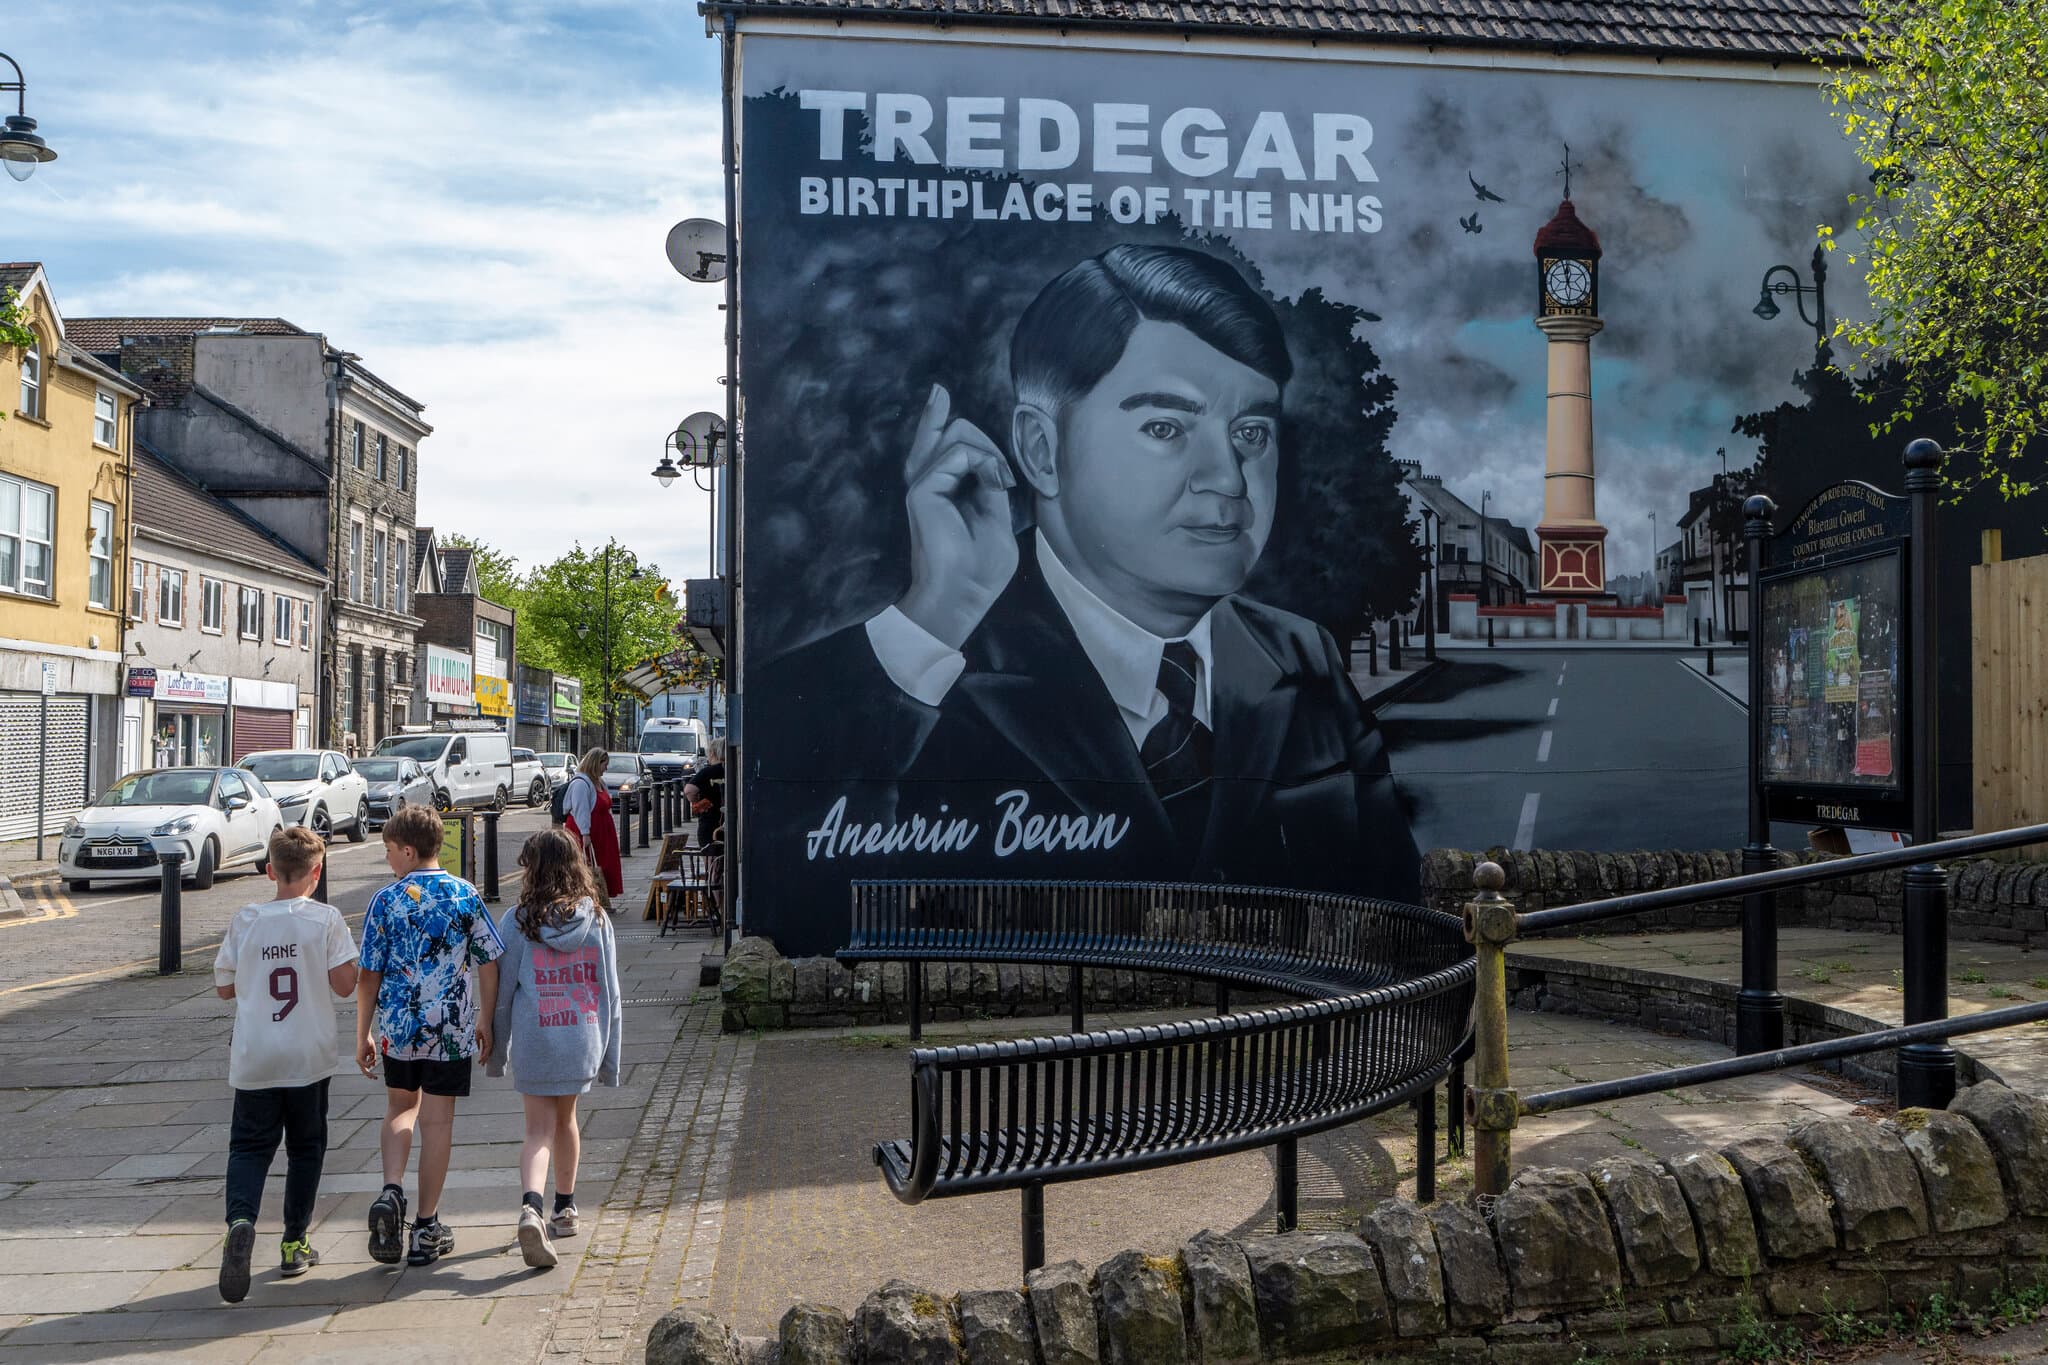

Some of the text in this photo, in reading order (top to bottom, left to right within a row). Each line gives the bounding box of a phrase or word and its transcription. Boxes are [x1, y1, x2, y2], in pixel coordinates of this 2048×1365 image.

[800, 89, 1379, 182] TREDEGAR
[800, 177, 1383, 233] BIRTHPLACE OF THE NHS
[1808, 507, 1866, 536] Blaenau Gwent
[1792, 524, 1884, 556] COUNTY BOROUGH COUNCIL
[168, 674, 180, 689] Lots
[429, 655, 470, 697] VILAMOURA
[807, 789, 1131, 861] Aneurin Bevan
[1816, 805, 1860, 821] TREDEGAR
[117, 847, 133, 856] XAR
[262, 944, 297, 960] KANE
[535, 962, 598, 985] BEACH
[269, 967, 299, 1022] 9
